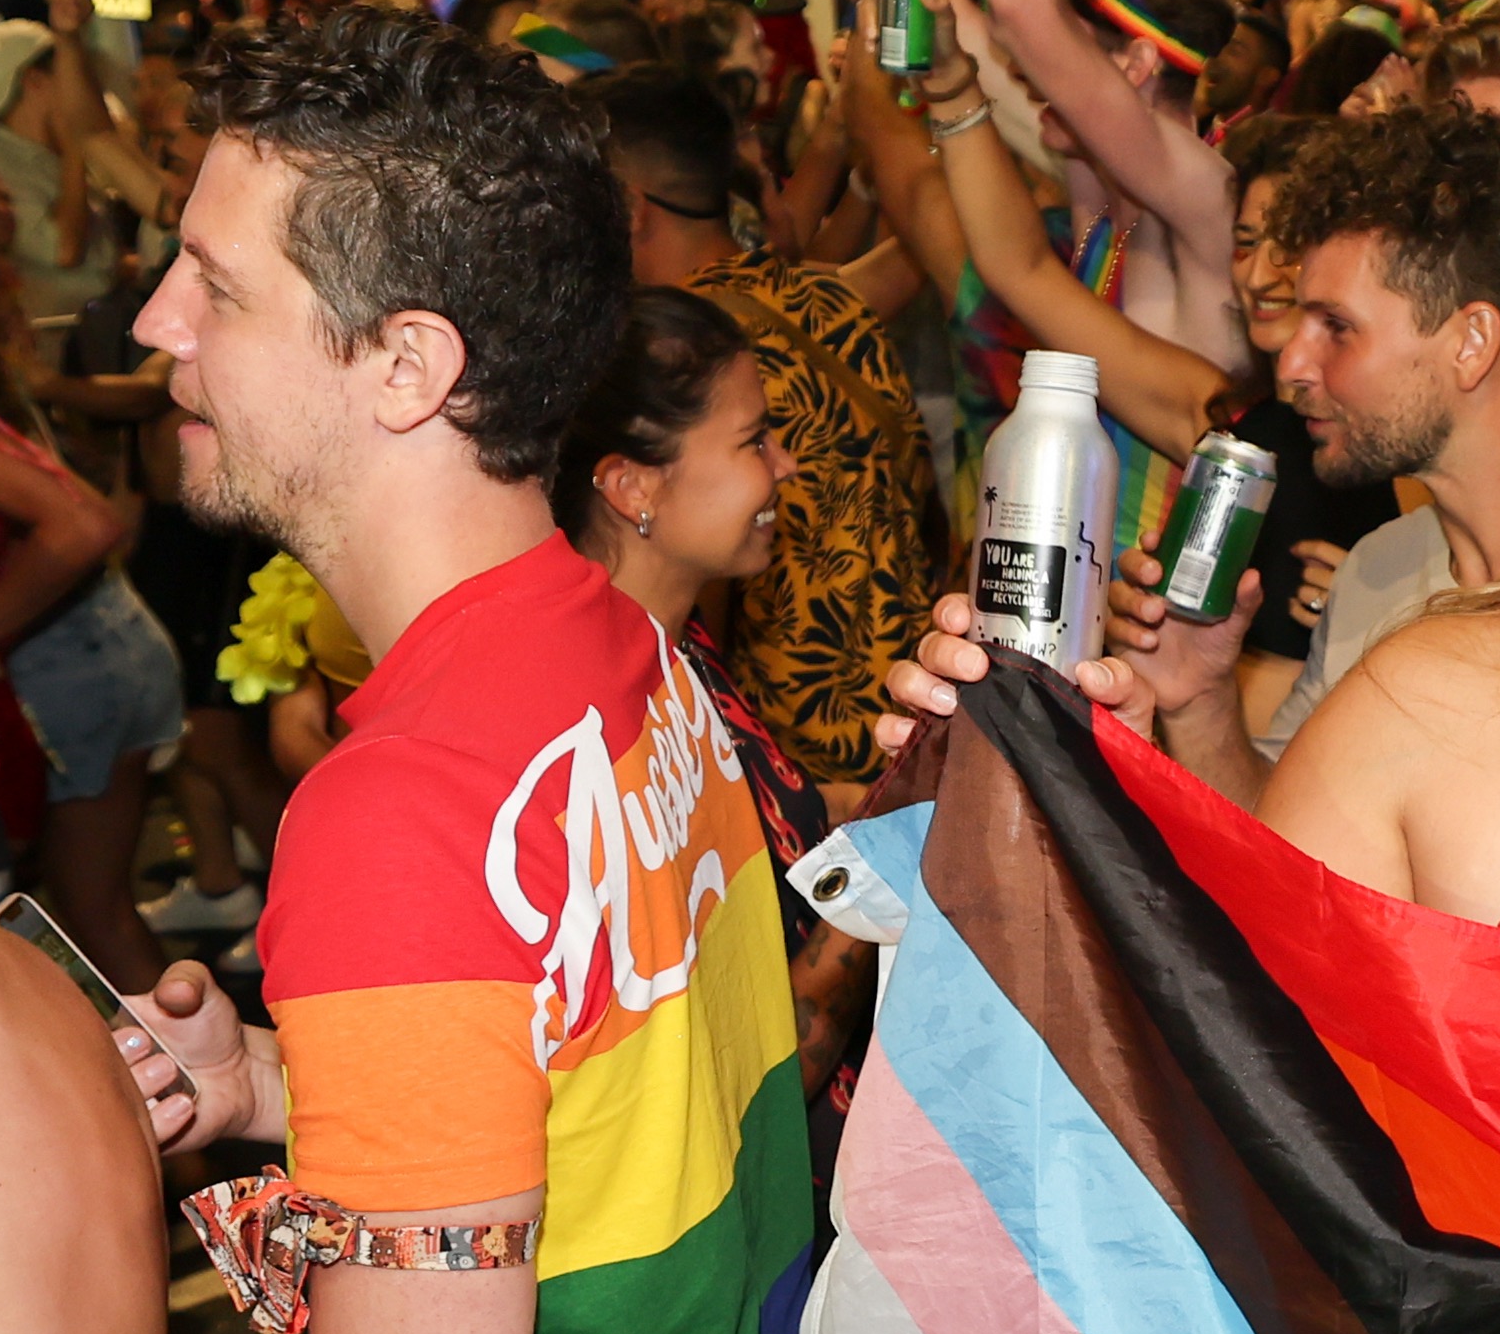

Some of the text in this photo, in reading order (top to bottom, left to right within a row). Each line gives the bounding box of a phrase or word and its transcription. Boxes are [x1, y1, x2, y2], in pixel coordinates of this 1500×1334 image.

[985, 542, 1036, 568] YOU ARE
[1001, 567, 1050, 585] HOLDING A
[992, 593, 1046, 609] RECYCLABLE
